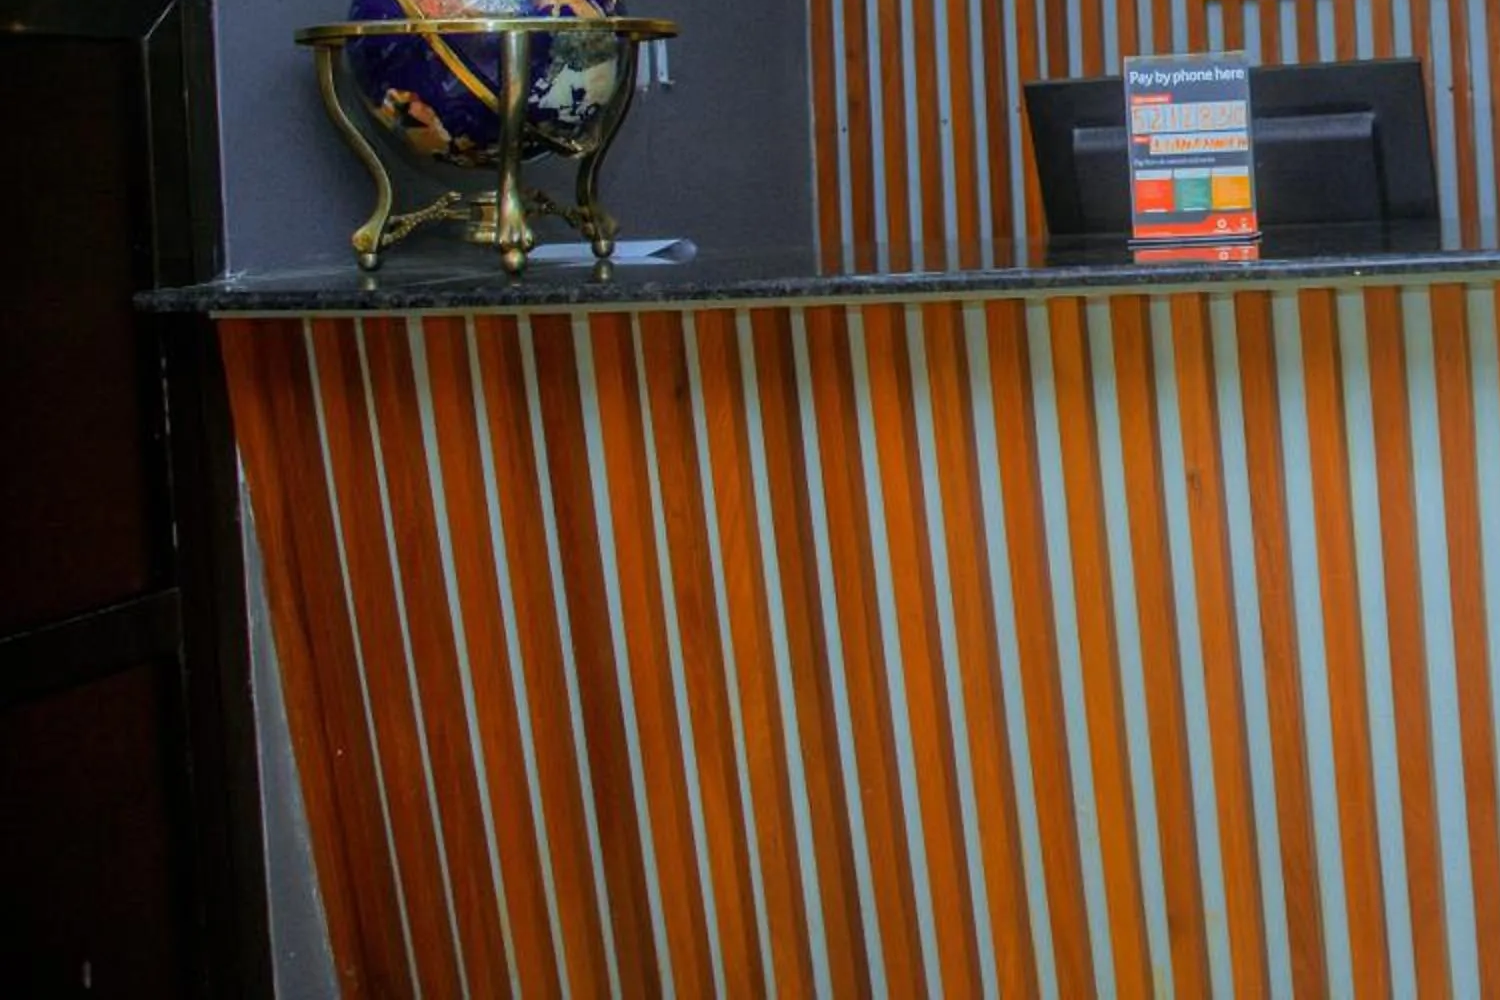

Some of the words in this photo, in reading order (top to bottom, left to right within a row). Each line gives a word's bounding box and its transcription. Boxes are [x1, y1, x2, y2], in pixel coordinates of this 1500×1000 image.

[1129, 71, 1153, 86] Pay
[1155, 70, 1171, 85] by
[1173, 68, 1213, 86] phone
[1215, 66, 1244, 80] here
